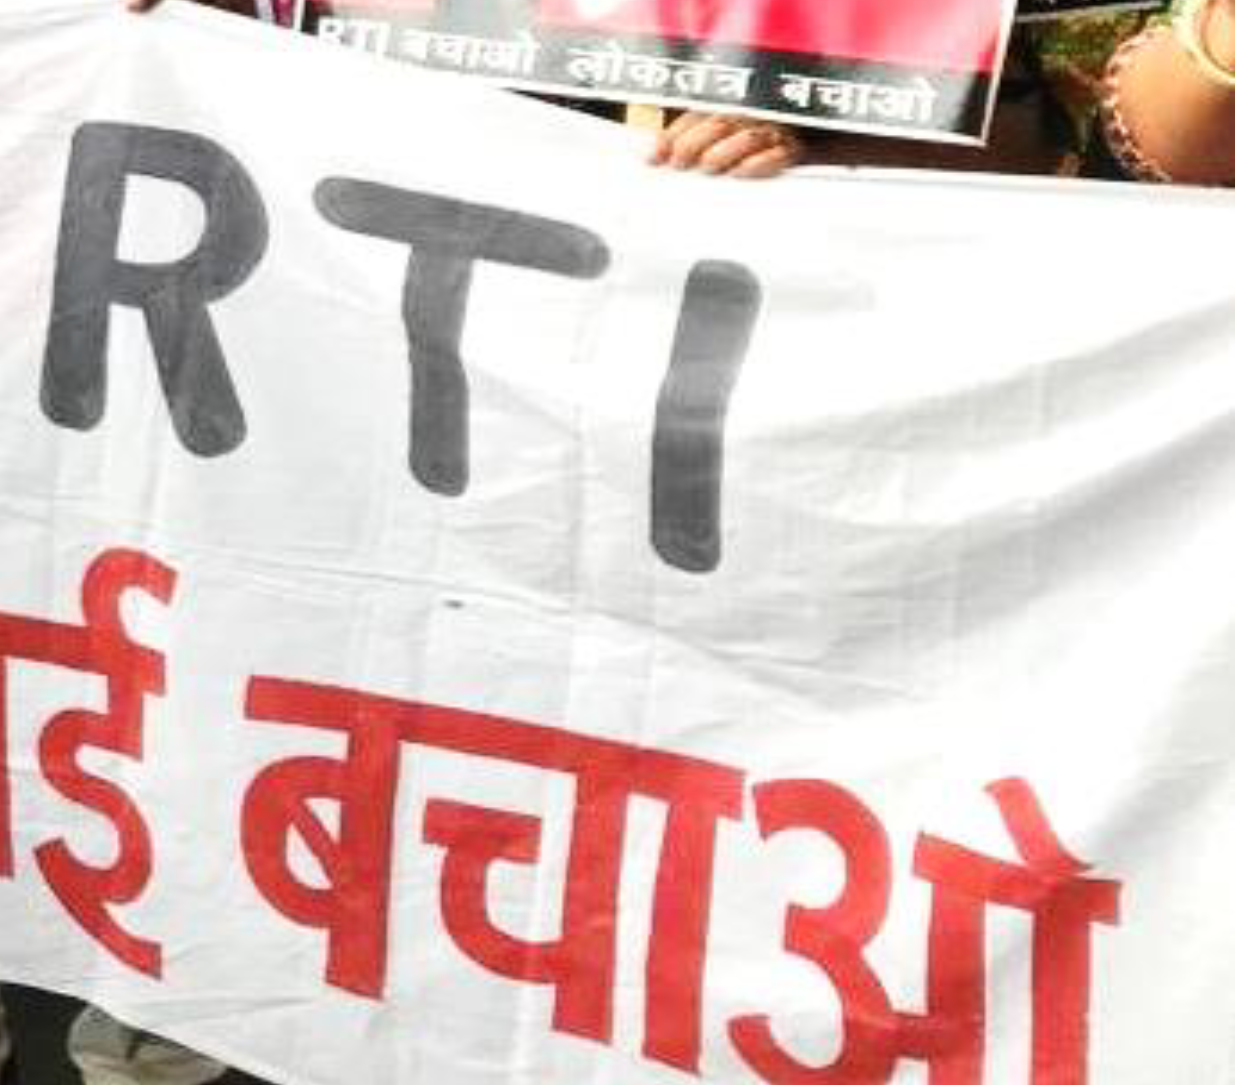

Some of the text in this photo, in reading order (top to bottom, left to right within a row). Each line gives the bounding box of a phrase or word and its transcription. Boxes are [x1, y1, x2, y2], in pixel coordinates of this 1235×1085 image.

[318, 17, 939, 122] RTI बचाओ लोकतंत्र बचाओ
[38, 120, 763, 574] RTI
[238, 673, 1122, 1085] बचाओ
